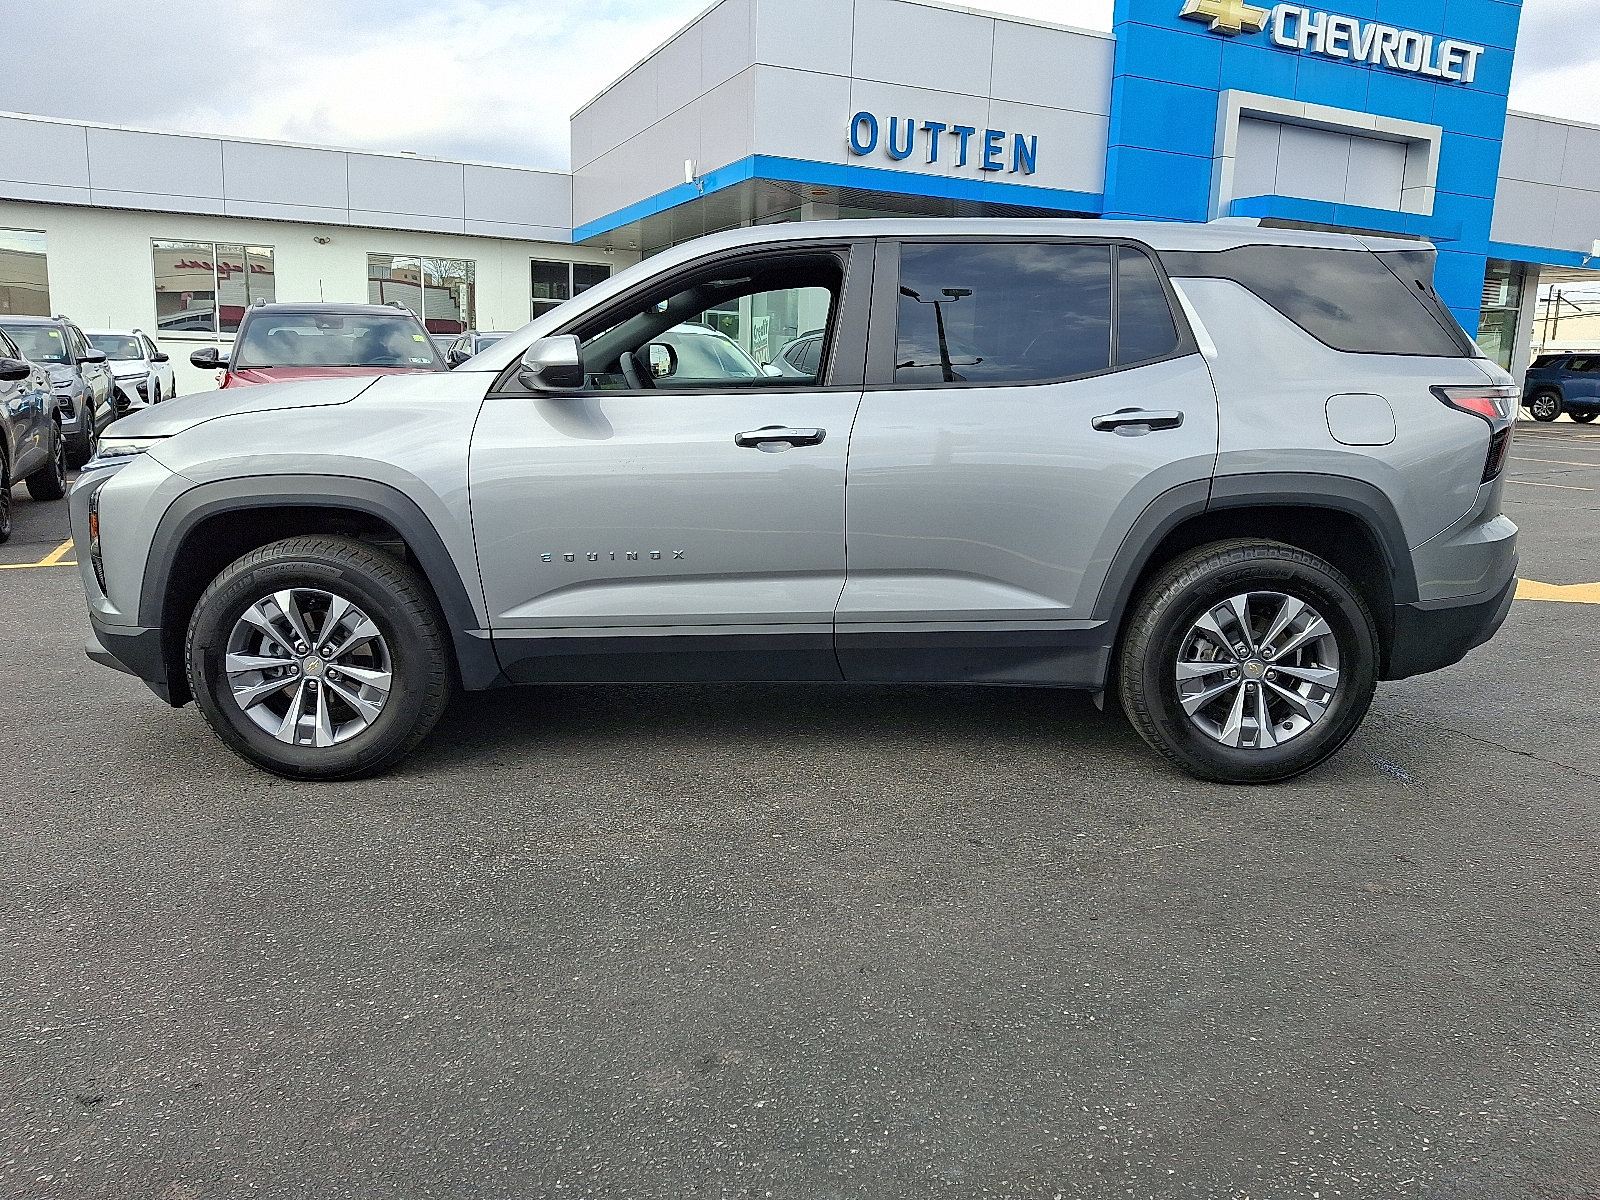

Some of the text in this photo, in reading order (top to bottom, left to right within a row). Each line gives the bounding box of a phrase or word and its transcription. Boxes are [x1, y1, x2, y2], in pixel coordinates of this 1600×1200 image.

[1271, 3, 1484, 83] CHEVROLET
[848, 111, 1038, 176] OUTTEN
[261, 564, 297, 575] PRIMACY
[541, 549, 684, 562] EQUINOX
